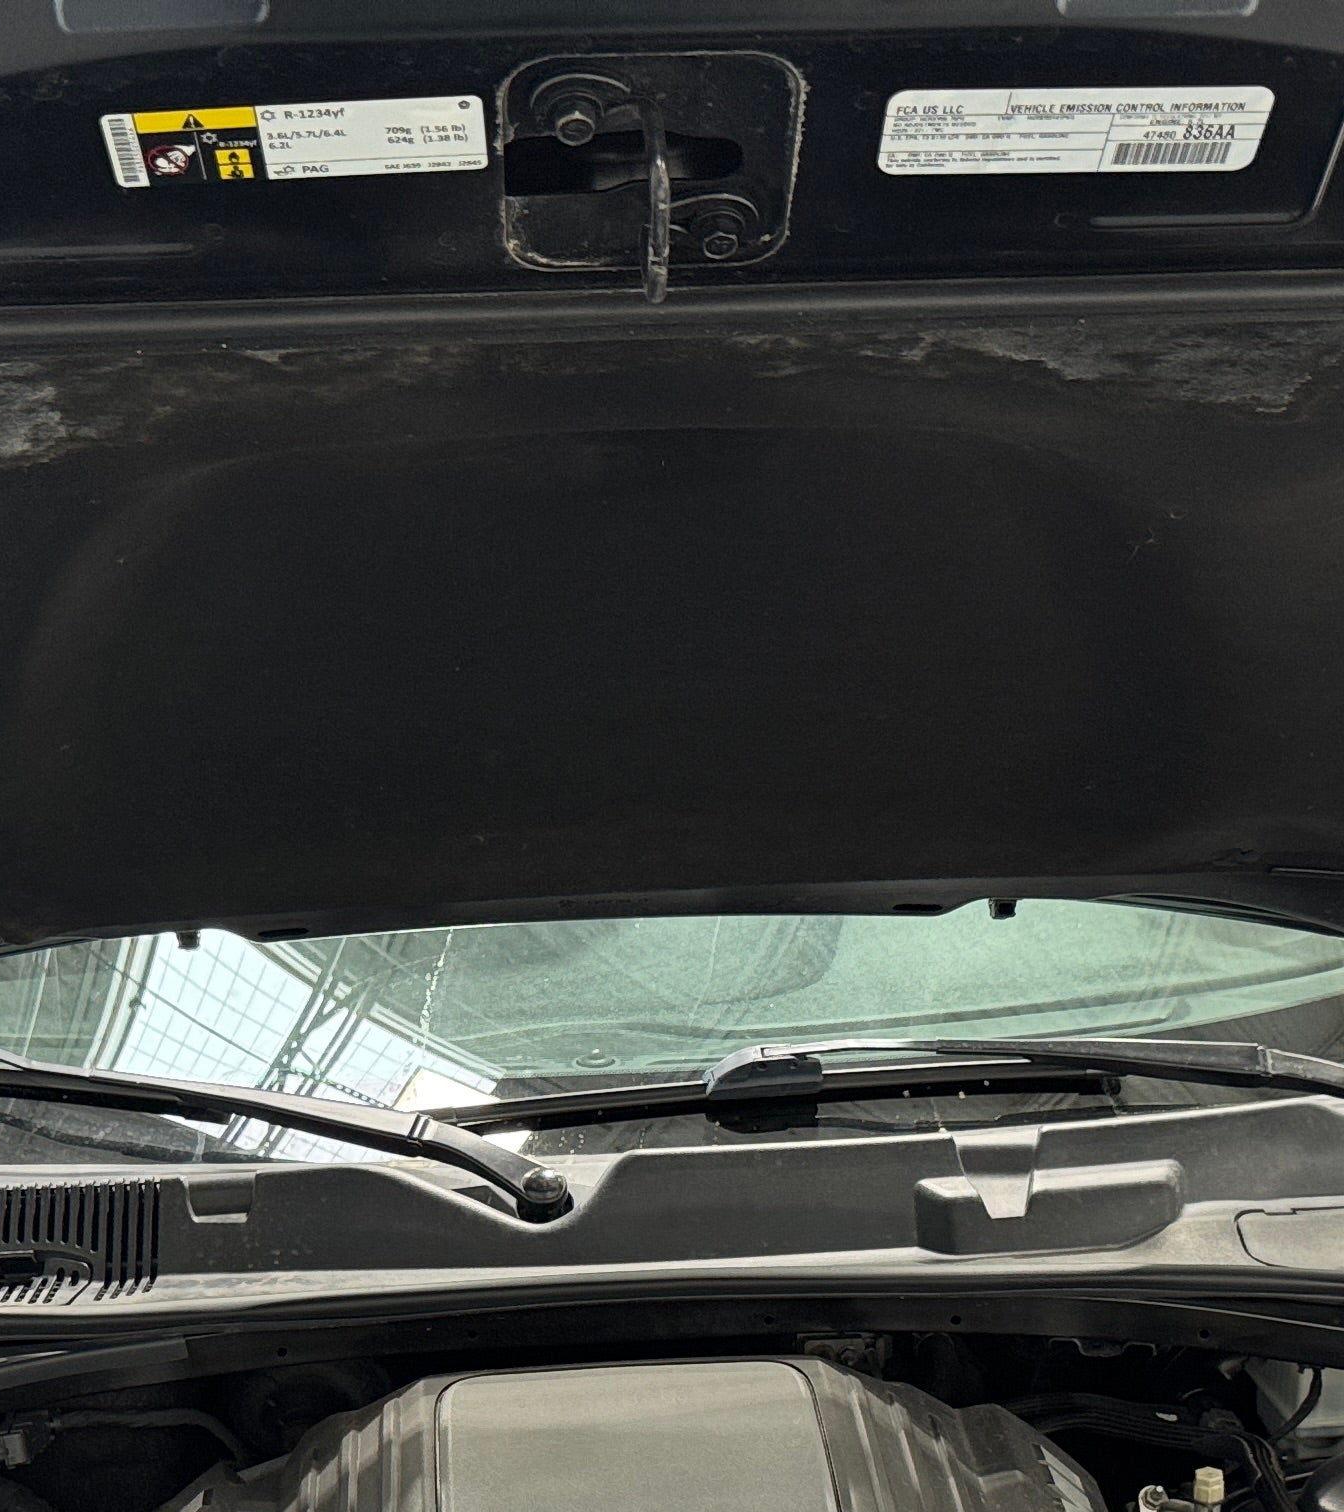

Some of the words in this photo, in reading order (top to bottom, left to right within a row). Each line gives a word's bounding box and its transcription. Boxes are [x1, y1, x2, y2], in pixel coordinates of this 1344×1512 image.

[284, 107, 345, 119] R-1234yf
[896, 105, 918, 115] FCA
[922, 105, 938, 114] US
[942, 104, 964, 114] LLC
[1010, 104, 1056, 113] VEHICLE
[1059, 103, 1112, 113] EMISSION
[1116, 103, 1165, 112] CONTROL
[1170, 102, 1246, 111] INFORMATION
[385, 126, 412, 135] 709g
[1182, 124, 1236, 140] 836AA
[302, 165, 330, 174] PAG
